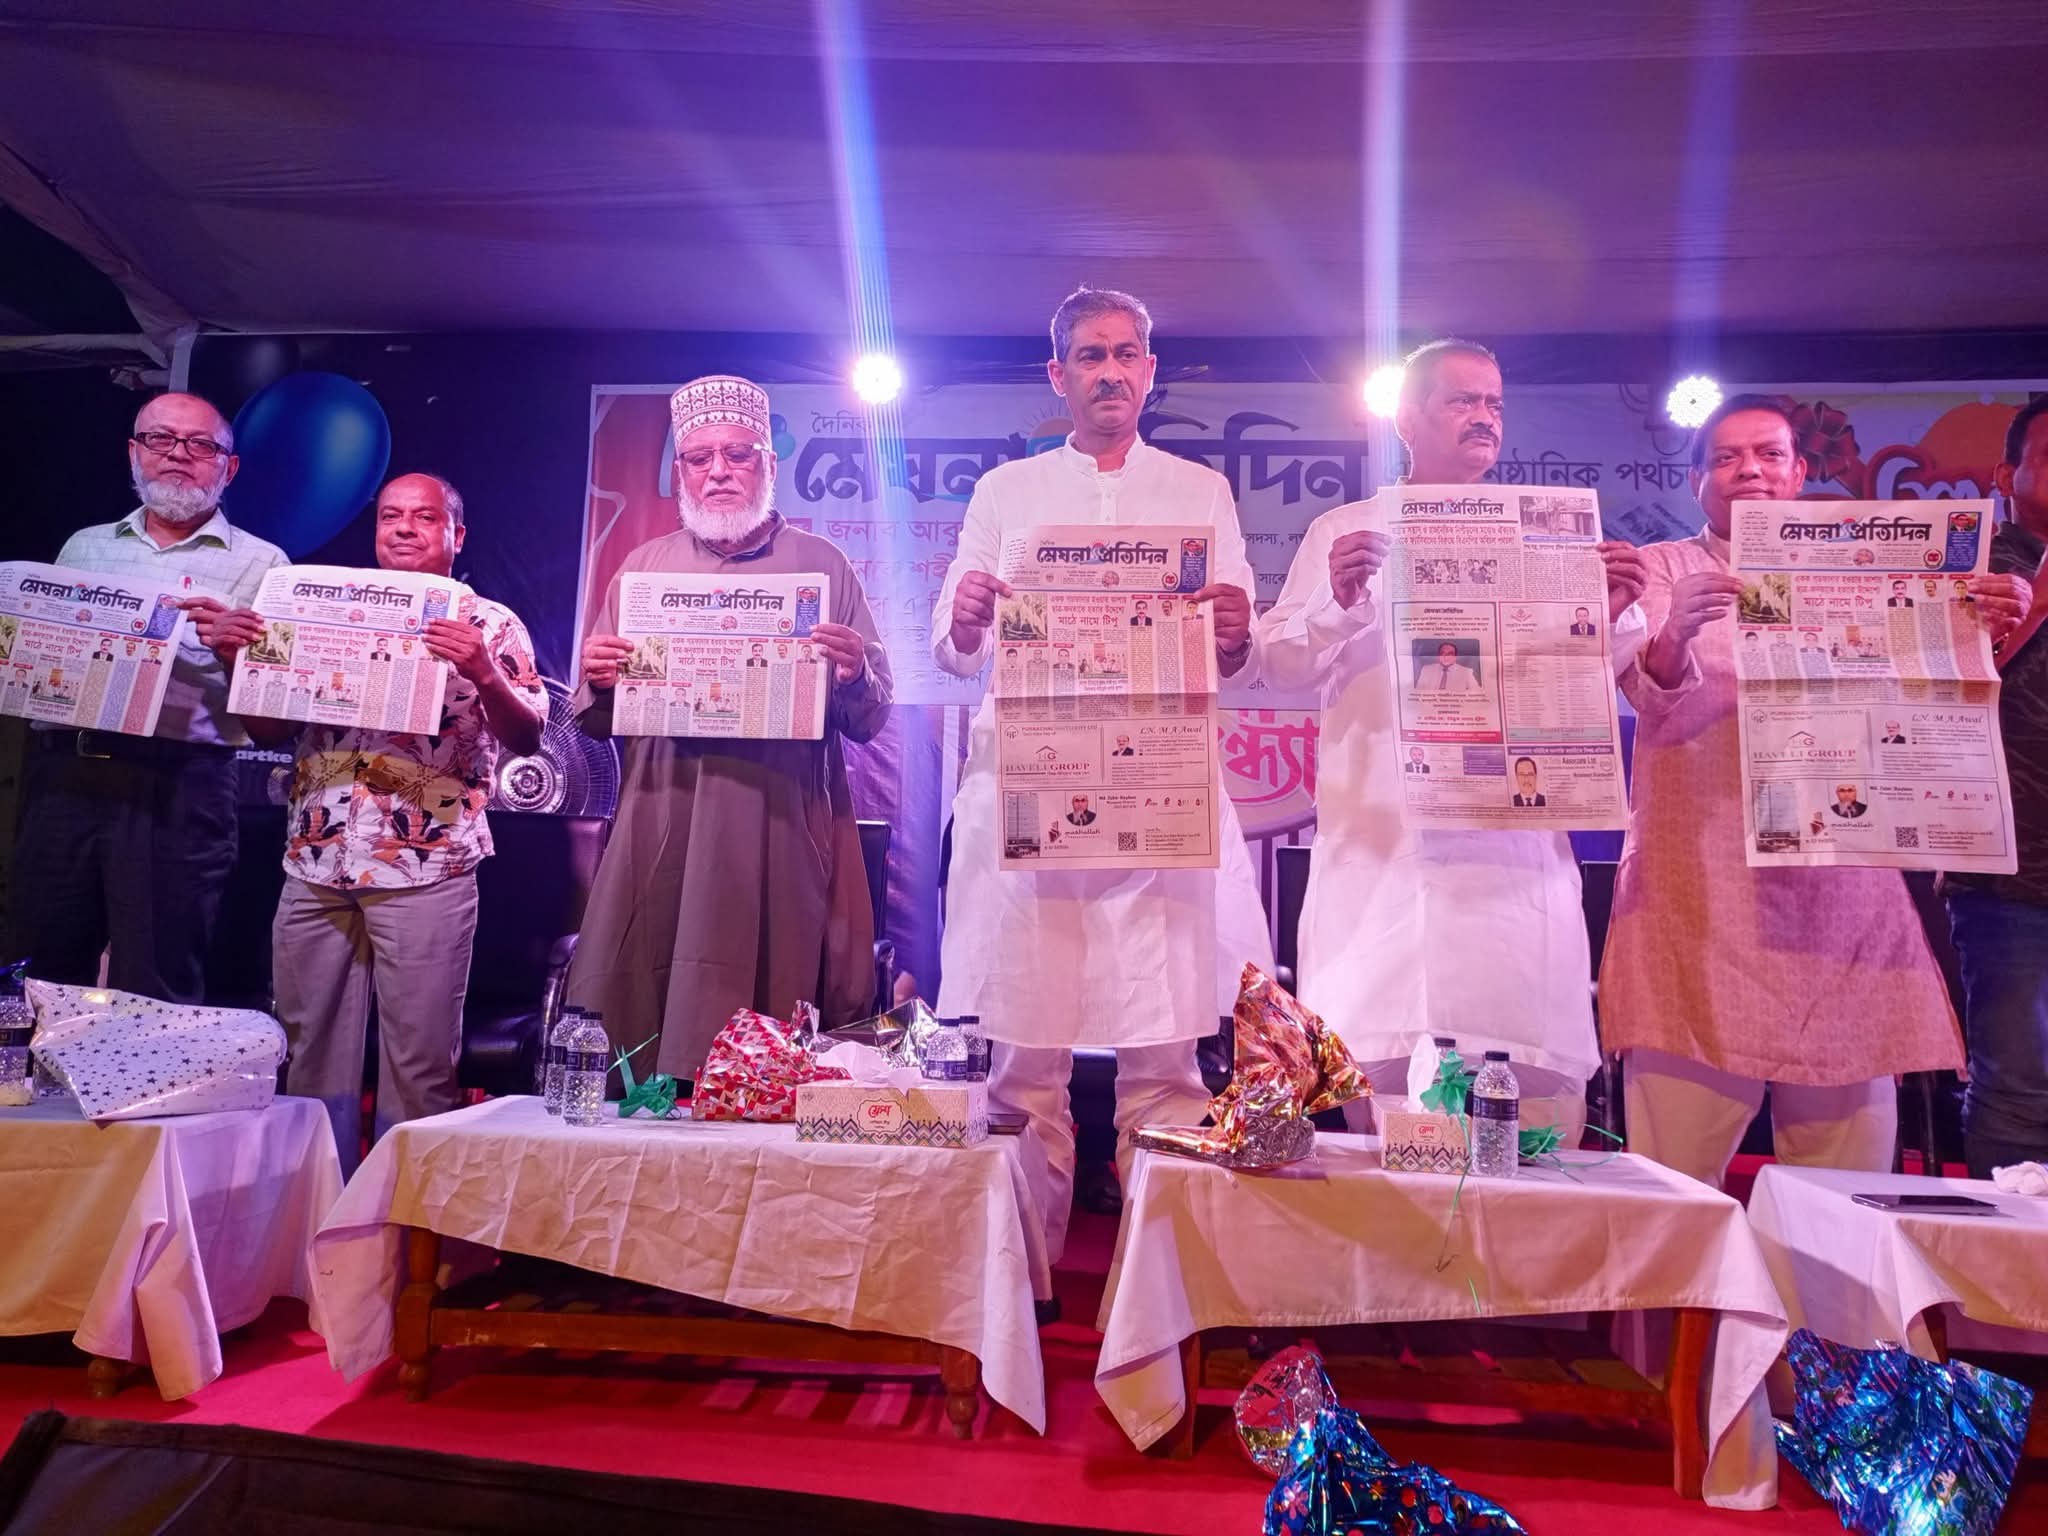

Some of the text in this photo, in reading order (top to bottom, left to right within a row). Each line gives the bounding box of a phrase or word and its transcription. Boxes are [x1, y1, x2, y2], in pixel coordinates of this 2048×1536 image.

[1616, 459, 1691, 492] পথচ
[907, 519, 963, 546] আবু
[1780, 516, 1932, 541] মেঘনা প্রতিদিন
[1037, 541, 1168, 565] মেঘনা প্রতিদিন
[293, 583, 414, 608] মেঘনা প্রতিদিন
[661, 589, 784, 611] মেঘনা প্রতিদিন
[236, 750, 293, 763] artke
[1050, 762, 1090, 771] GROUP
